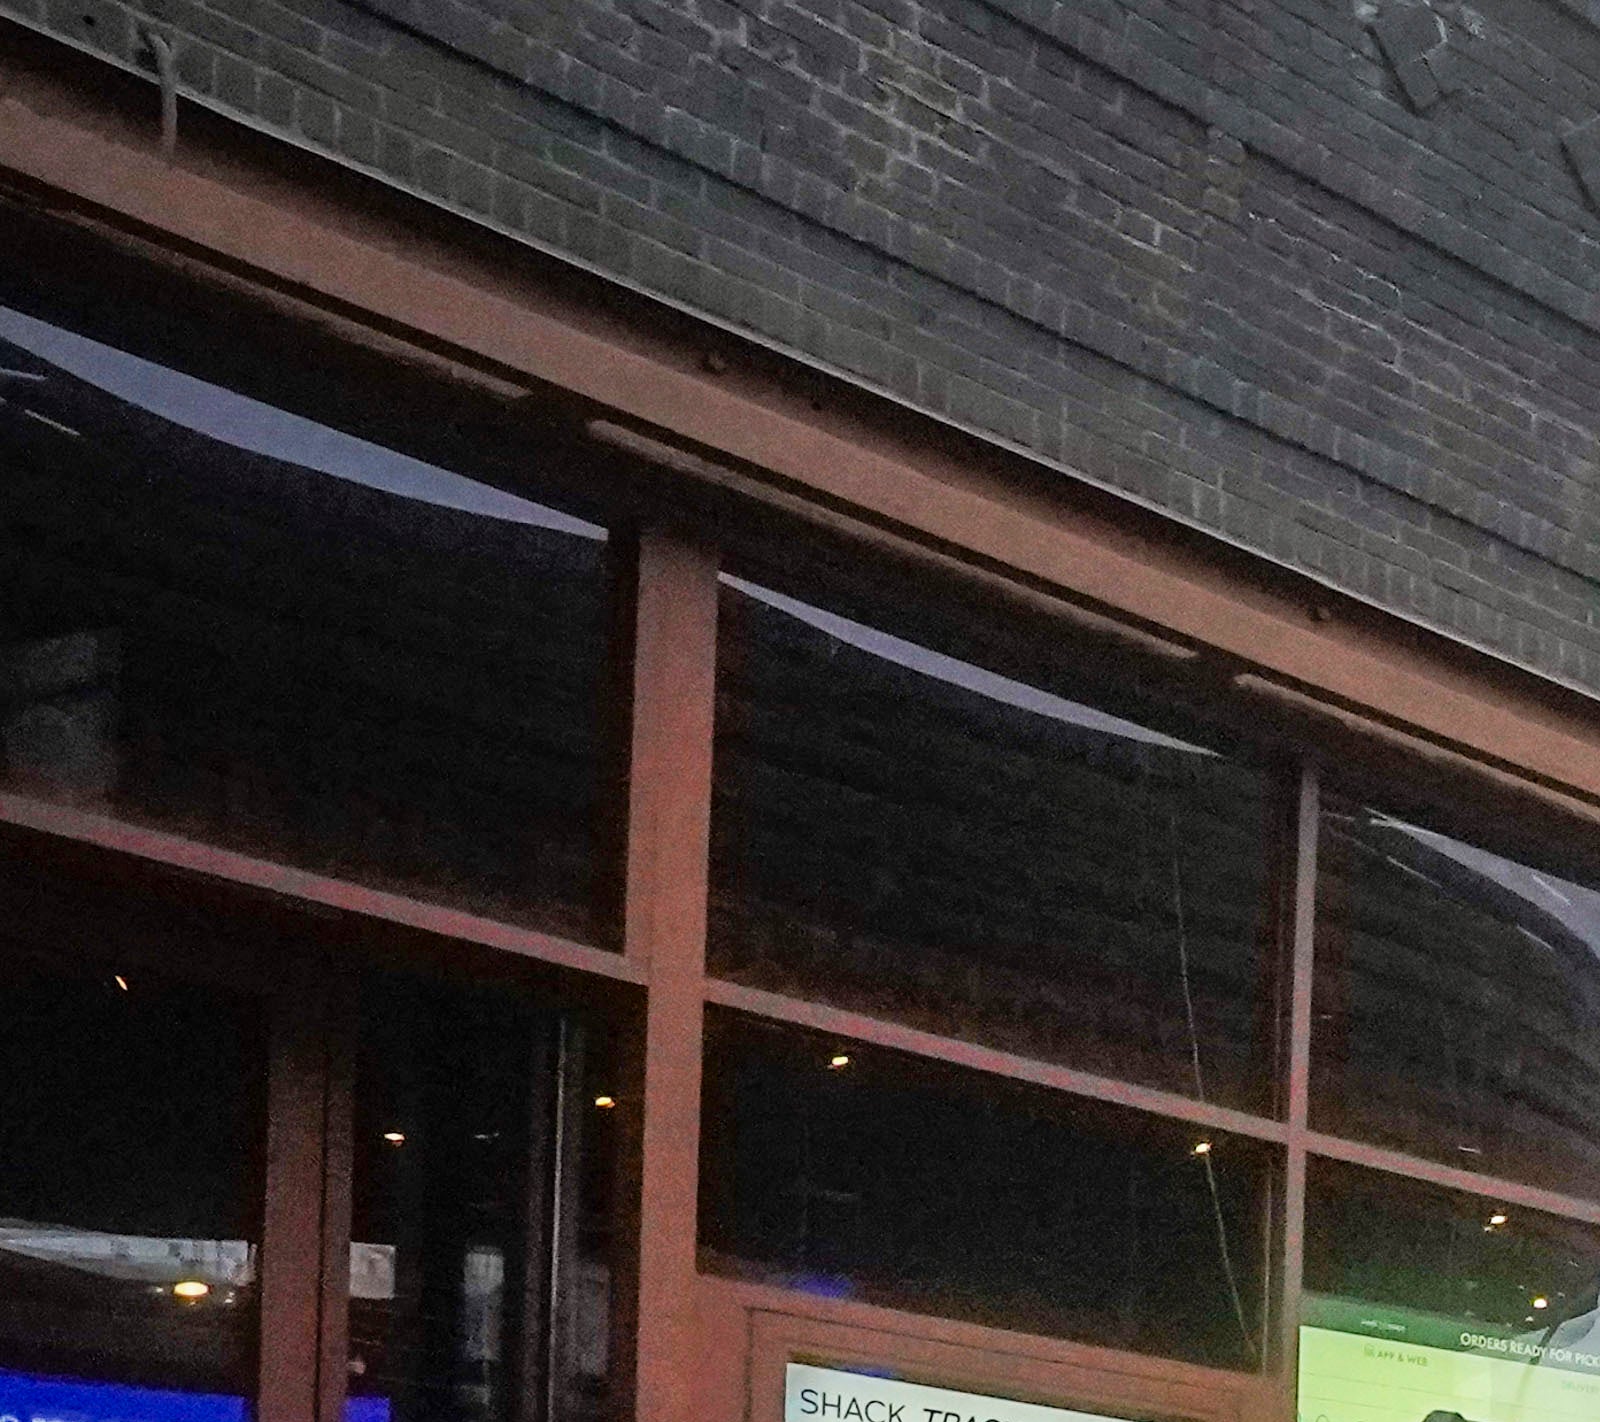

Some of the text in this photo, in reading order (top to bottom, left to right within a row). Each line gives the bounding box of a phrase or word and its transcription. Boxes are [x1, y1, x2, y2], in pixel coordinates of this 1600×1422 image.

[1459, 1332, 1507, 1351] ORDERS
[1508, 1340, 1547, 1358] READY
[1548, 1347, 1572, 1363] FOR
